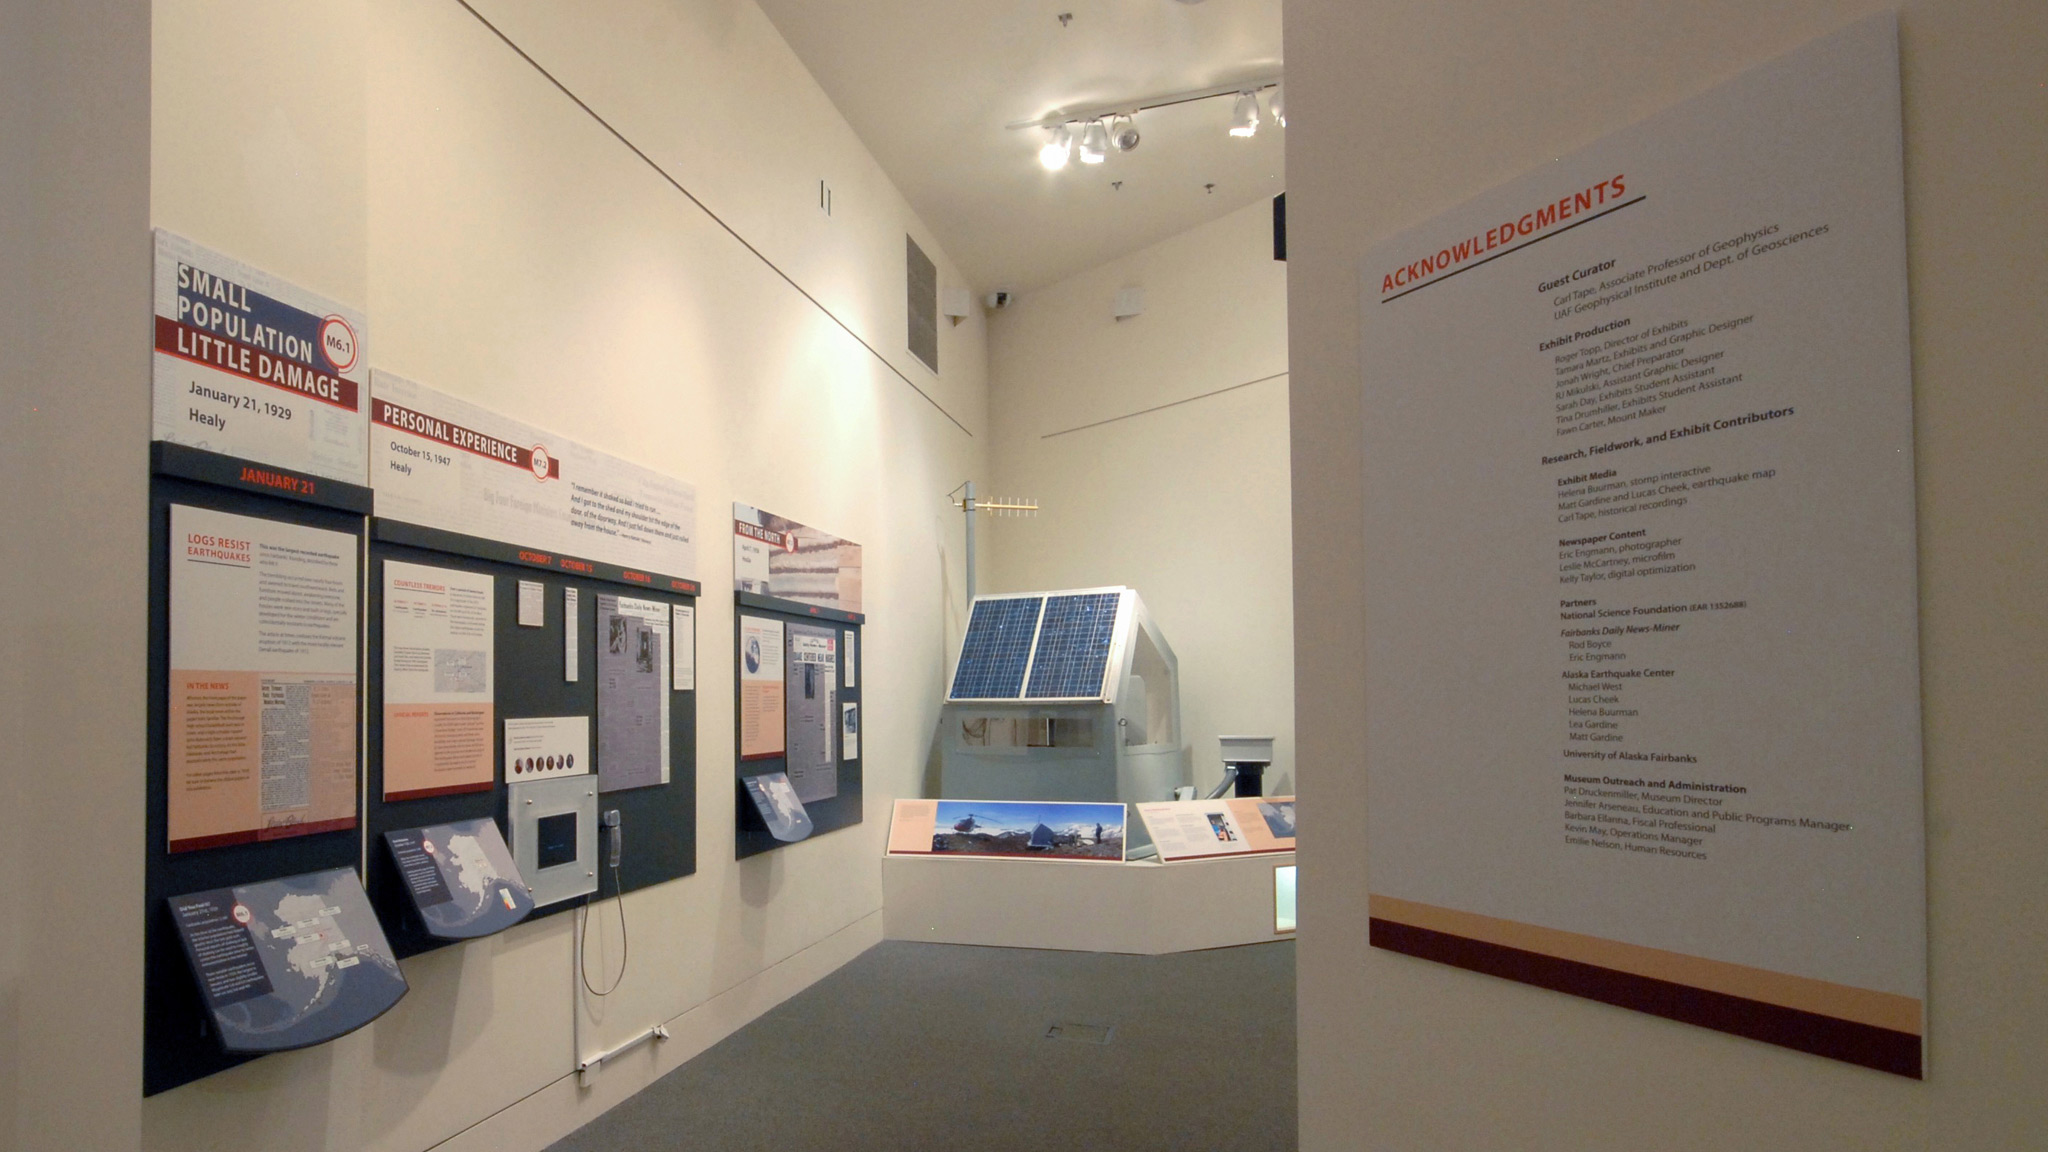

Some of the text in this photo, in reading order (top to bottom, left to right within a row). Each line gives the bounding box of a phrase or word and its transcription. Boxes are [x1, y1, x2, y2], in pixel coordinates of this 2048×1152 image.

[1381, 174, 1627, 294] ACKNOWLEDGMENTS
[1539, 260, 1615, 293] Guest Curator
[1554, 291, 1571, 307] Carl
[1599, 269, 1645, 291] Associate
[1648, 252, 1696, 275] Professor
[1698, 244, 1710, 258] of
[1712, 224, 1780, 254] Geophysics
[1554, 225, 1830, 320] UAF Geophysical Institute and Dept. of Geosciences
[178, 264, 252, 313] SMALL
[178, 295, 312, 364] POPULATION
[1539, 319, 1631, 352] Exhibit Production
[326, 335, 351, 355] M6.1
[1555, 351, 1578, 364] Roger
[1604, 334, 1639, 350] Director
[1640, 329, 1650, 340] of
[1652, 320, 1689, 337] Exhibits
[1556, 362, 1584, 376] Tamara
[1613, 344, 1648, 360] Exhibits
[1649, 337, 1668, 350] and
[1669, 327, 1706, 345] Graphic
[1708, 315, 1754, 334] Designer
[178, 328, 340, 402] LITTLE DAMAGE
[1556, 348, 1685, 387] Jonah Wright, Chief Preparator
[188, 381, 292, 421] January 21, 1929
[189, 407, 226, 432] Healy
[383, 404, 451, 442] PERSONAL
[452, 428, 518, 464] EXPERIENCE
[1542, 408, 1795, 465] Research, Fieldwork, and Exhibit Contributors
[390, 441, 451, 468] October 15, 1947
[390, 460, 412, 477] Healy
[1557, 469, 1617, 486] Exhibit Media
[239, 467, 316, 495] JANUARY 21
[1558, 488, 1586, 498] Helena
[1630, 475, 1659, 486] stomp
[1660, 466, 1712, 481] interactive
[1558, 500, 1577, 510] Matt
[1578, 495, 1611, 507] Gardine
[1613, 490, 1630, 502] and
[1631, 489, 1656, 499] Lucas
[1692, 472, 1750, 489] earthquake
[1752, 469, 1776, 480] map
[187, 533, 251, 552] LOGS RESIST
[1559, 529, 1646, 547] Newspaper Content
[1559, 538, 1681, 559] Eric Engmann, photographer
[187, 546, 251, 563] EARTHQUAKES
[518, 550, 547, 565] OCTOBER
[1559, 551, 1676, 571] Leslie McCartney, microfilm
[1560, 599, 1597, 608] Partners
[1560, 609, 1596, 620] National
[1598, 608, 1631, 617] Science
[1633, 603, 1688, 615] Foundation
[1561, 623, 1680, 637] Fairbanks Daily News-Miner
[1568, 639, 1612, 649] Rod Boyce
[1569, 652, 1627, 662] Eric Engmann
[1562, 668, 1675, 679] Alaska Earthquake Center
[186, 682, 230, 691] IN THE NEWS
[1568, 682, 1623, 691] Michael West
[1568, 694, 1619, 703] Lucas Cheek
[1563, 749, 1698, 763] University of Alaska Fairbanks
[1564, 774, 1747, 794] Museum Outreach and Administration
[1641, 791, 1682, 803] Museum
[1683, 794, 1723, 806] Director
[1565, 798, 1596, 809] Jennifer
[1642, 804, 1689, 817] Education
[1691, 809, 1710, 819] and
[1712, 809, 1743, 821] Public
[1745, 812, 1797, 826] Programs
[1799, 816, 1851, 832] Manager
[1565, 822, 1588, 832] Kevin
[1610, 826, 1659, 840] Operations
[1660, 832, 1703, 846] Manager
